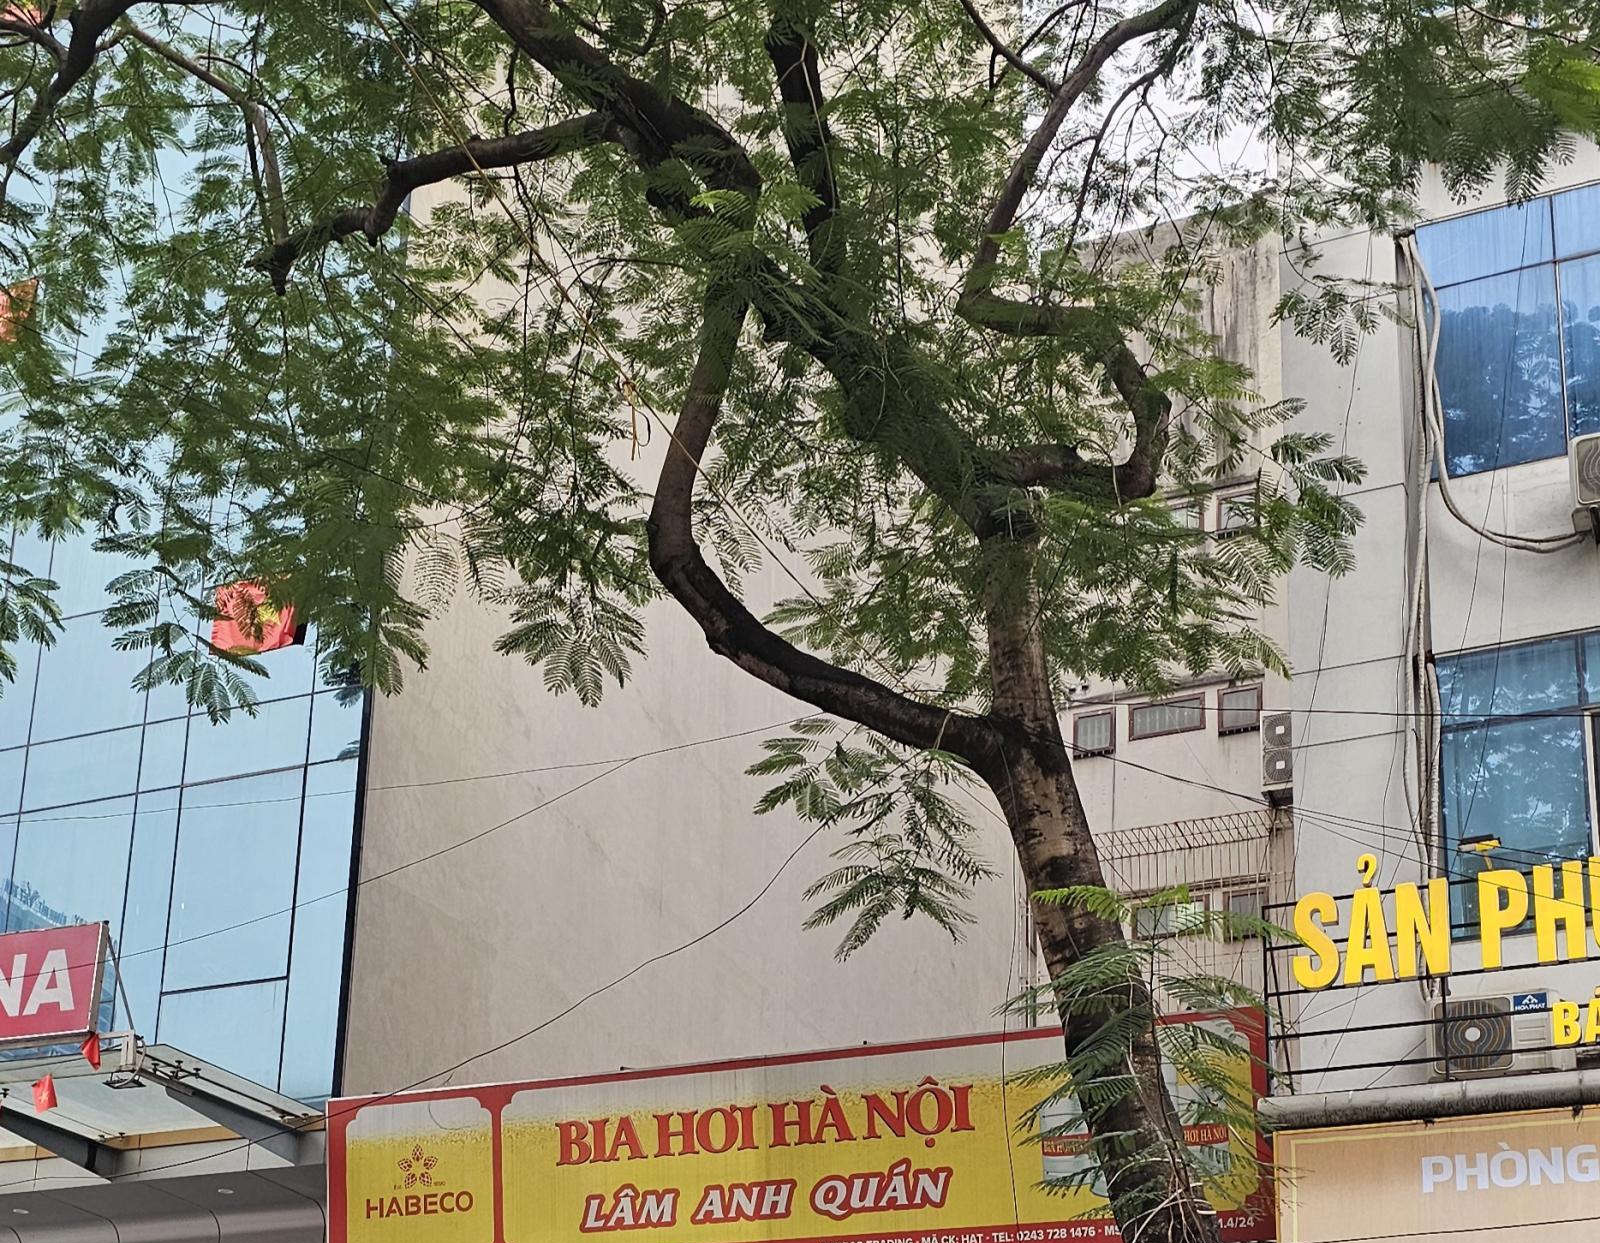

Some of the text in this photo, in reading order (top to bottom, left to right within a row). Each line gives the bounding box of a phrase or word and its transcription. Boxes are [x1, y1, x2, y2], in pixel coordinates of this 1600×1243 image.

[1293, 853, 1600, 991] SẢN PH
[555, 1075, 976, 1166] BIA HƠI HÀ NỘI
[584, 1163, 946, 1230] LÂM ANH QUÁN
[1421, 1141, 1600, 1193] PHÒNG
[366, 1191, 473, 1219] HABECO
[961, 1233, 984, 1243] HAT
[992, 1232, 1014, 1243] TEL:
[1016, 1230, 1044, 1241] 0243
[1046, 1228, 1067, 1239] 728
[1069, 1226, 1096, 1237] 1476
